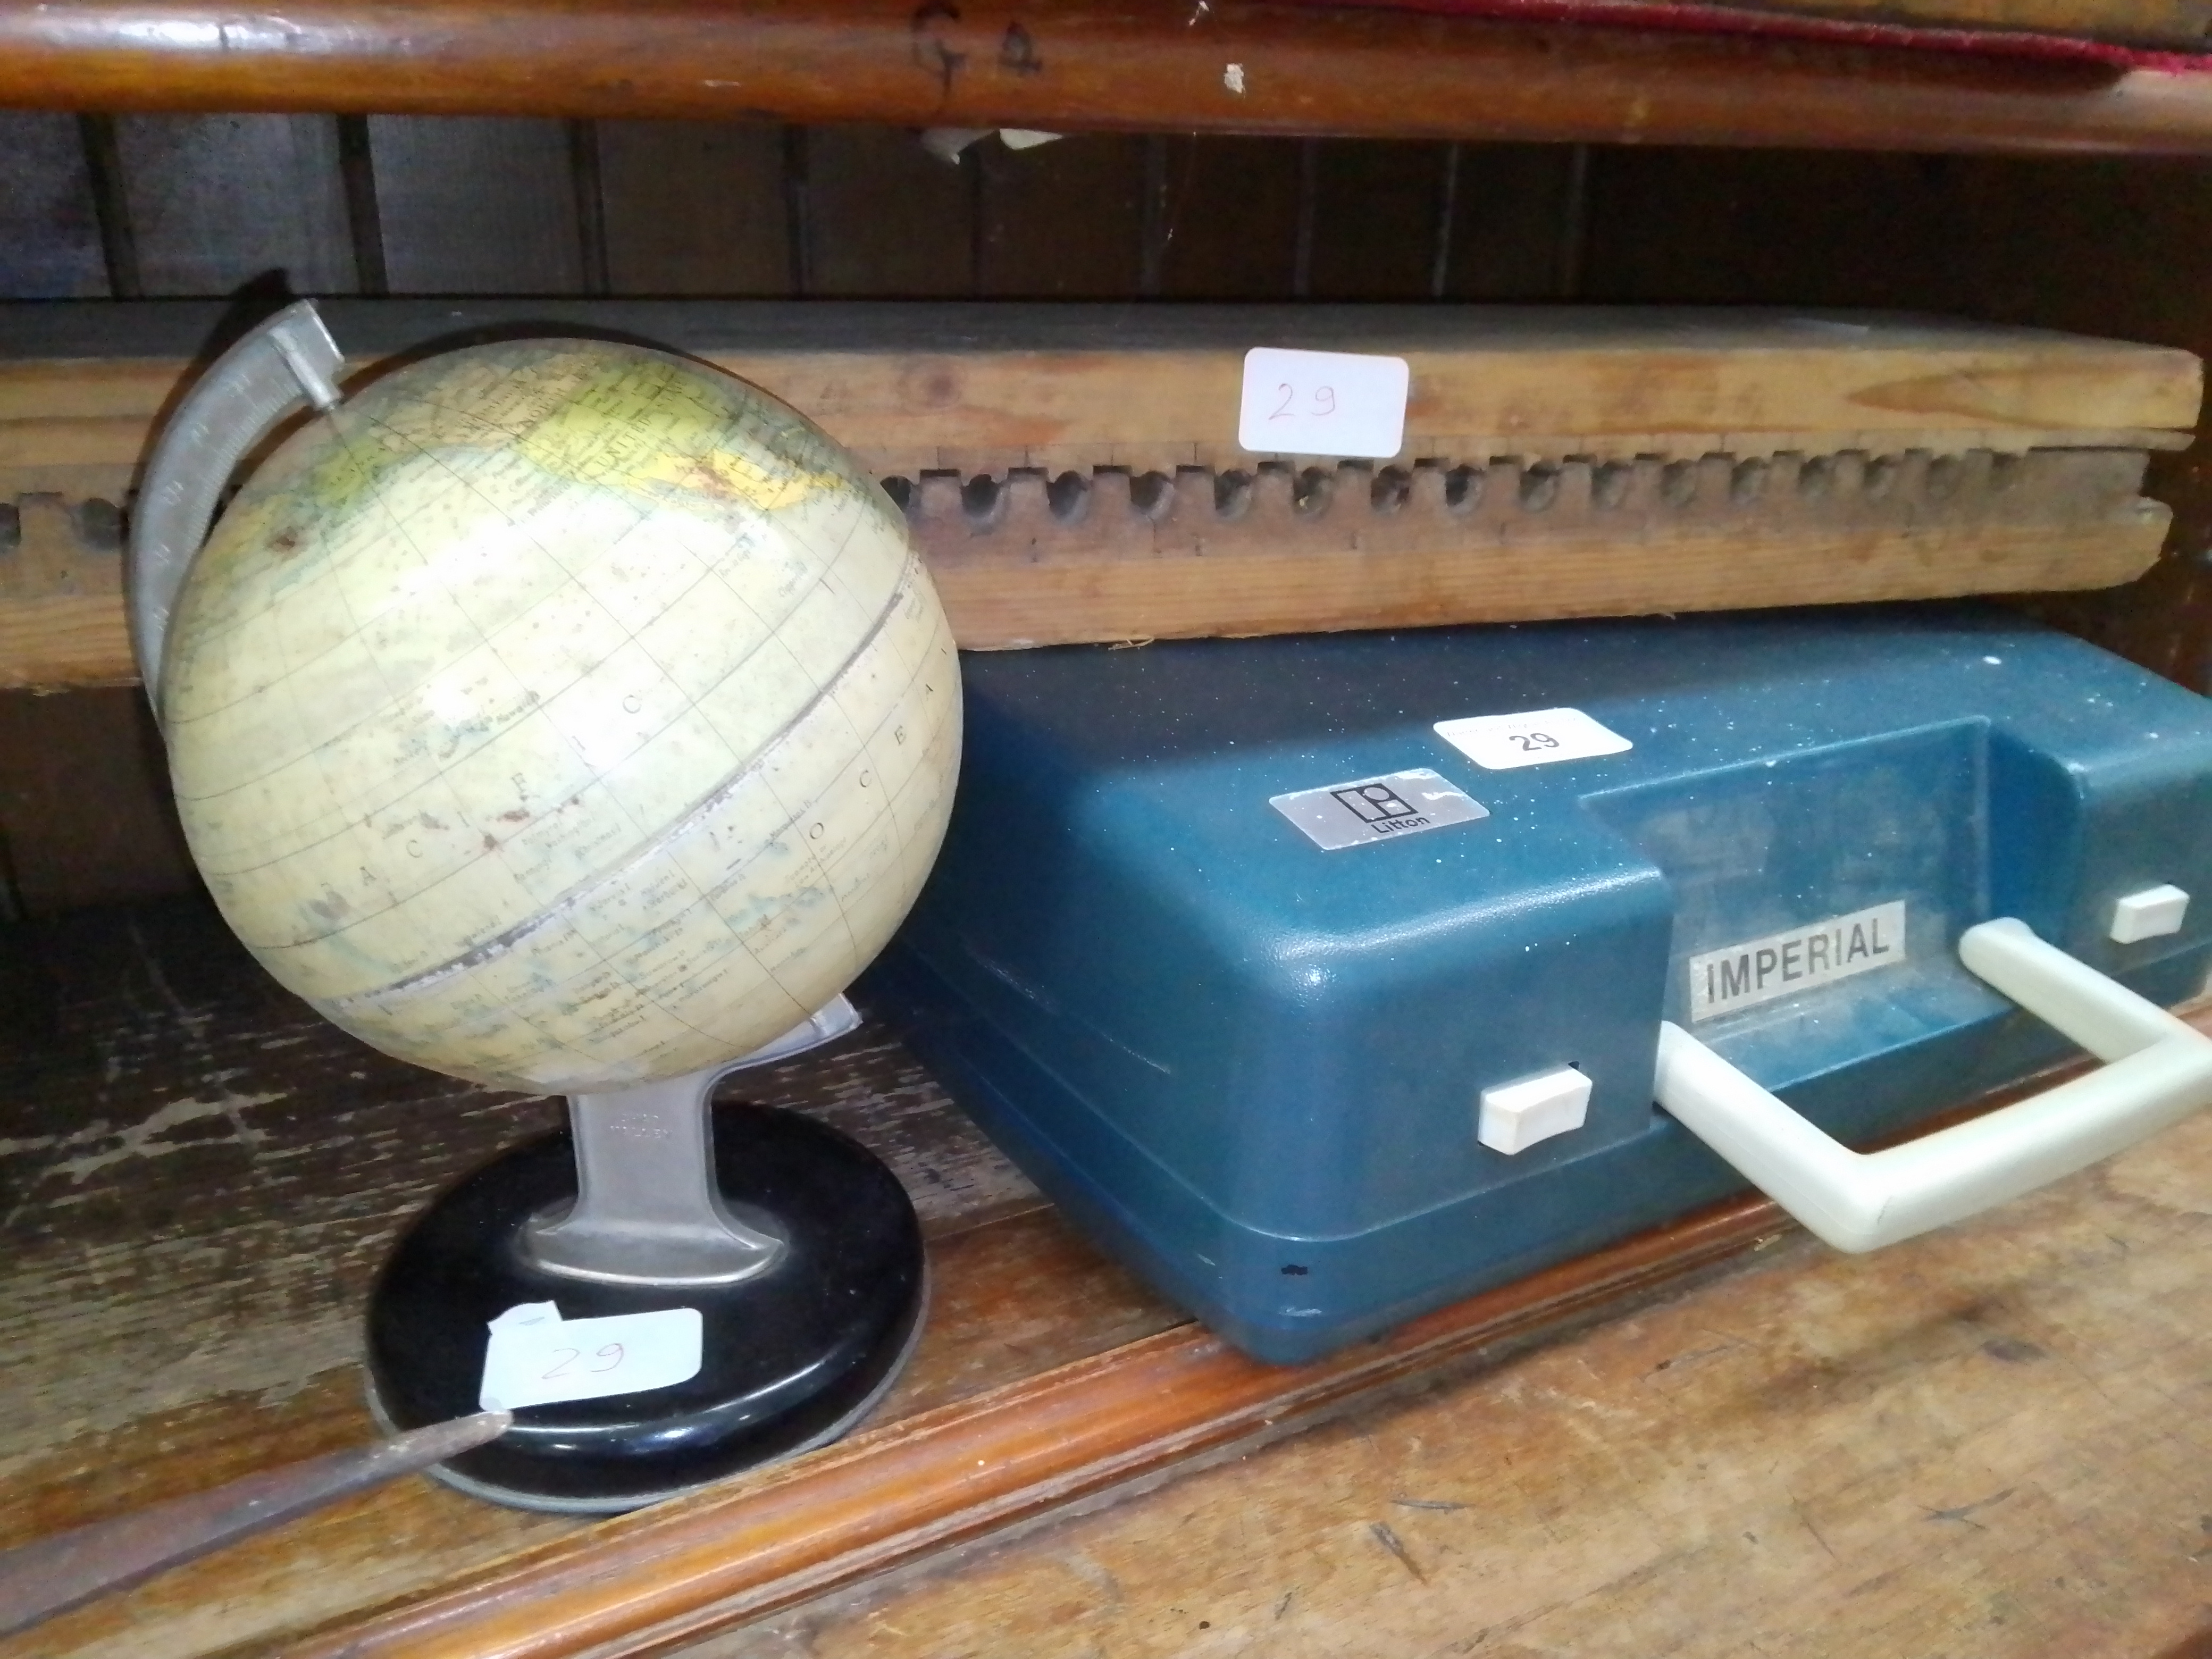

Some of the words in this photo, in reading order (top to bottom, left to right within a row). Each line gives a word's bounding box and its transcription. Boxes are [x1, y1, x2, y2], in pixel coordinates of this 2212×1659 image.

[1268, 383, 1336, 421] 29
[1509, 733, 1560, 752] 29
[1371, 816, 1431, 834] Litton
[1707, 918, 1890, 1003] IMPERIAL
[541, 1343, 625, 1379] 29
